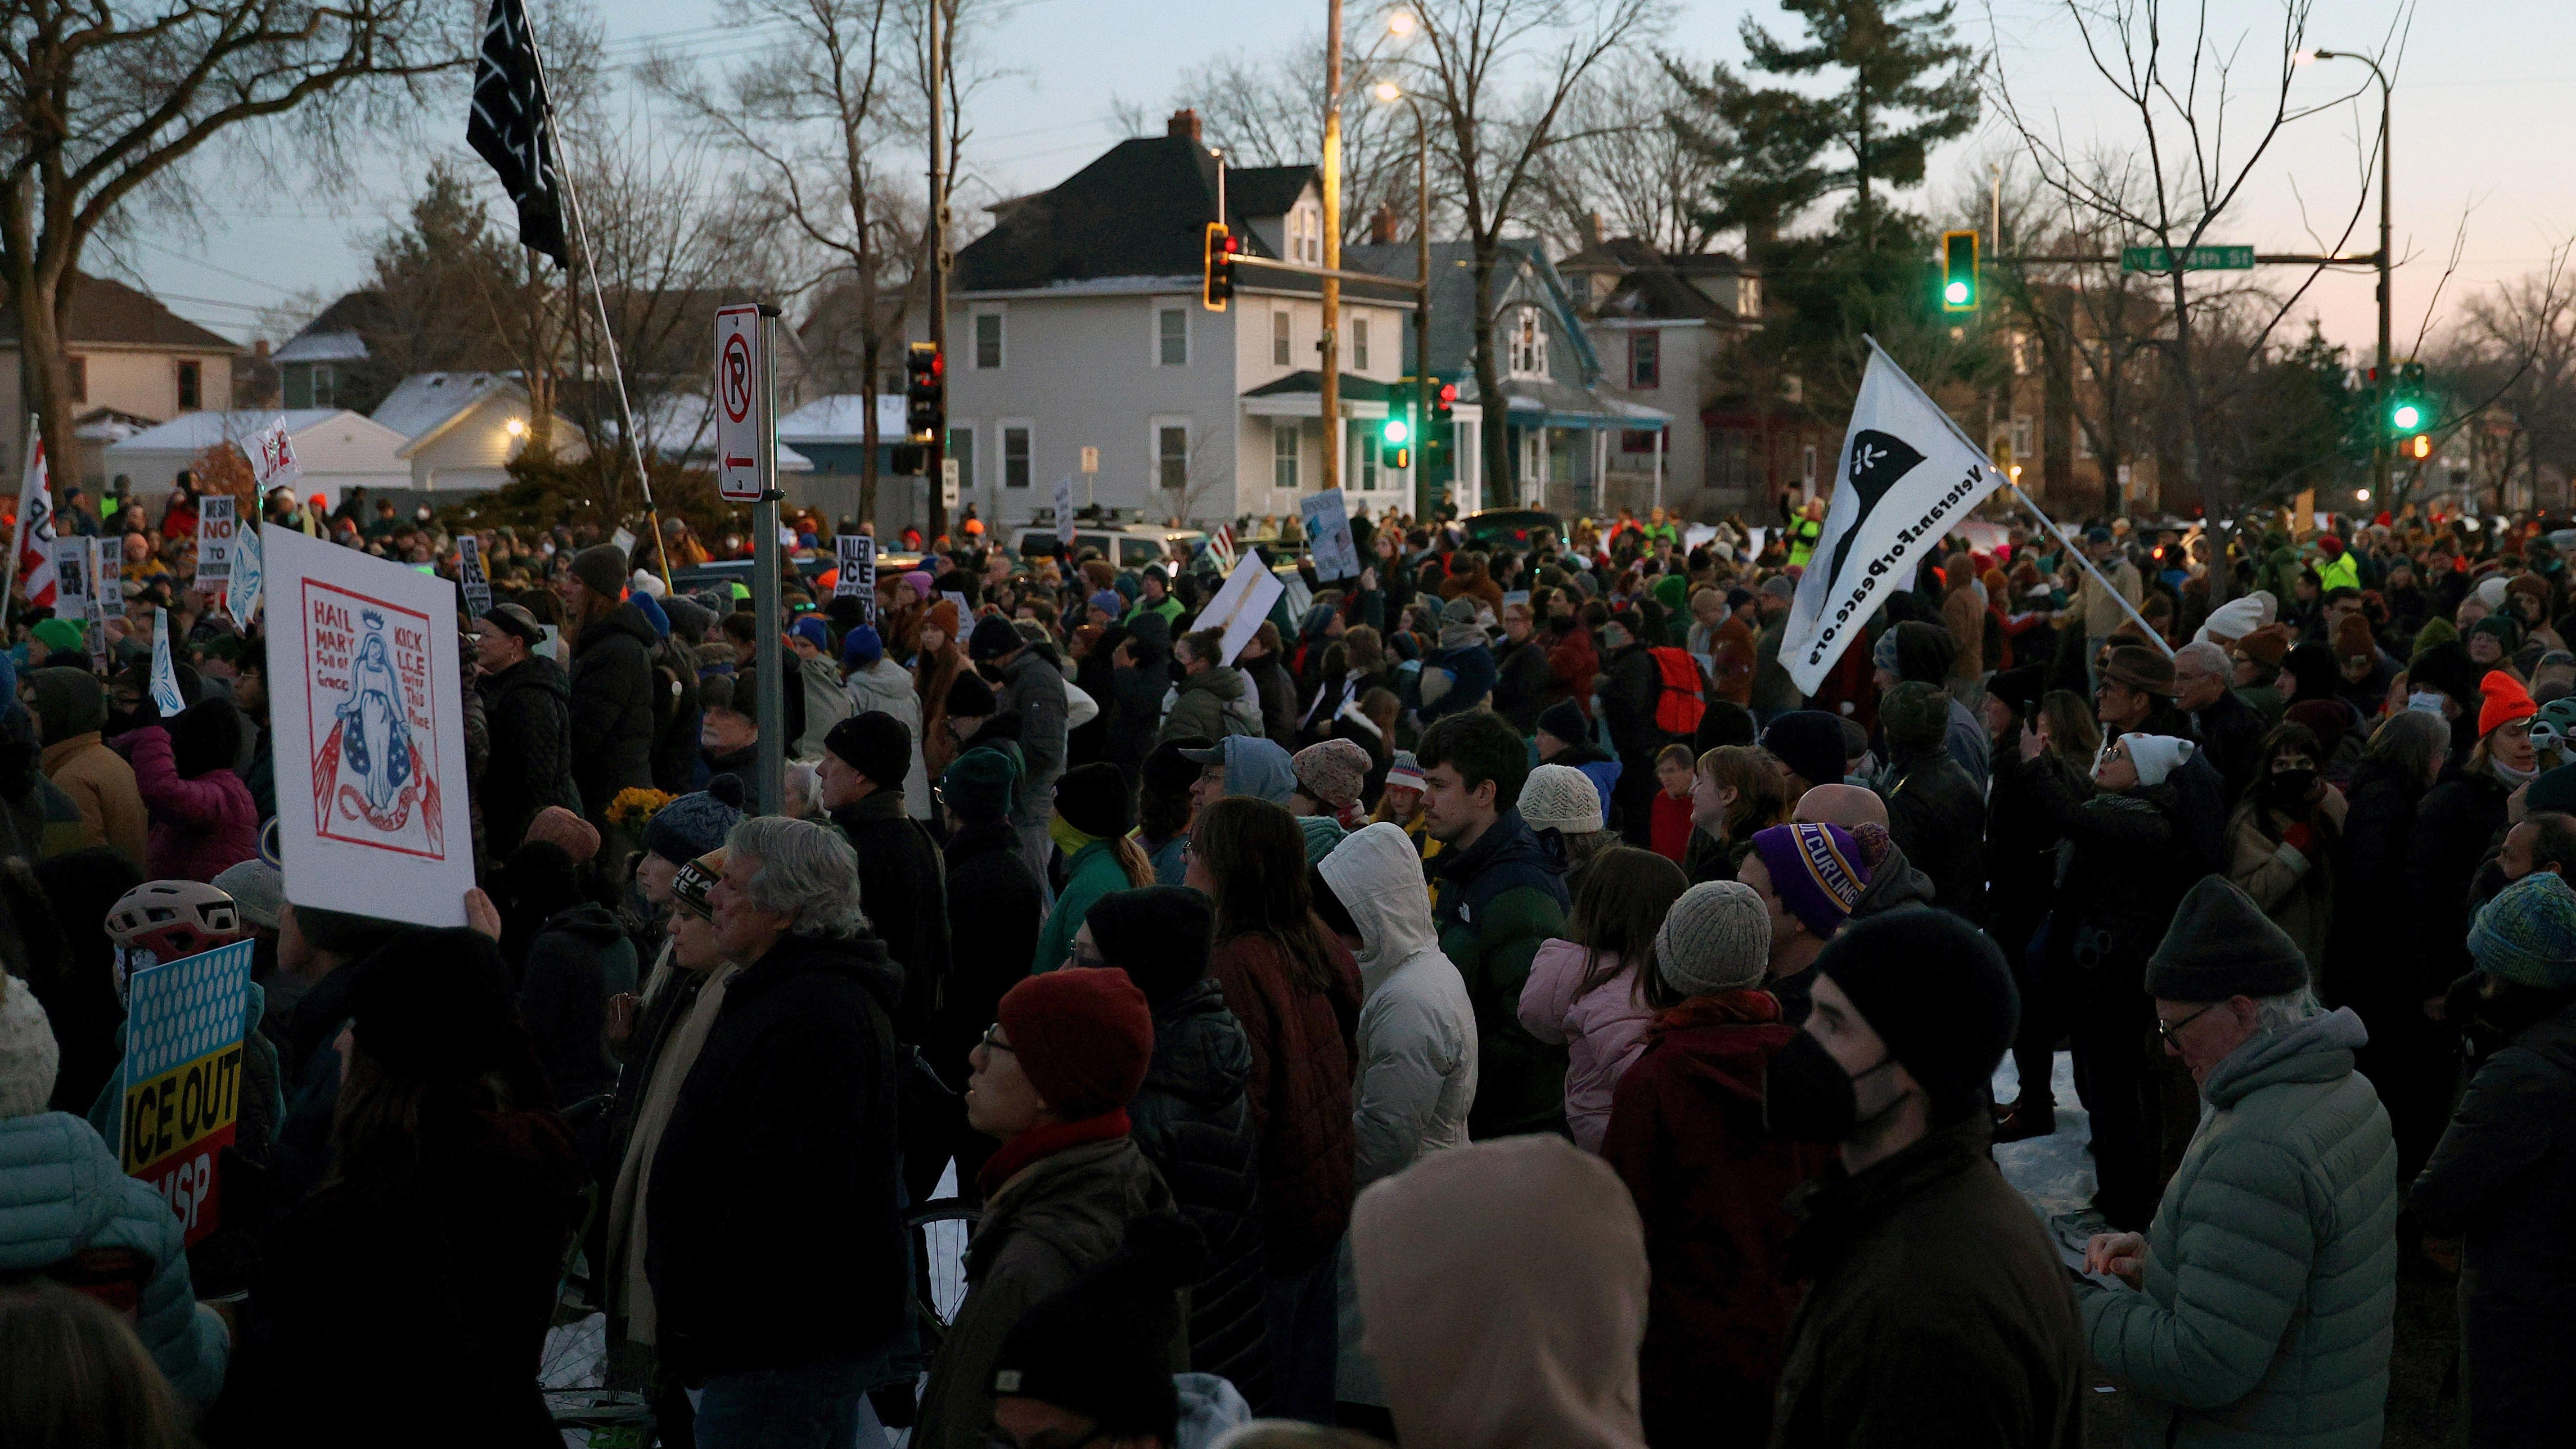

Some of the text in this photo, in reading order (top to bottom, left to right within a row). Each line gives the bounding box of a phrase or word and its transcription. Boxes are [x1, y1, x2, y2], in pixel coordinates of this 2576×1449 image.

[2173, 250, 2220, 266] 4th
[2229, 250, 2249, 266] St
[204, 520, 231, 539] NO
[209, 547, 224, 560] TO
[462, 562, 486, 584] ICE
[840, 560, 872, 584] ICE
[314, 600, 354, 633] HAIL
[316, 628, 354, 655] MARY
[395, 626, 423, 652] KICK
[1805, 835, 1858, 906] CURLING
[123, 1048, 241, 1174] ICE OUT
